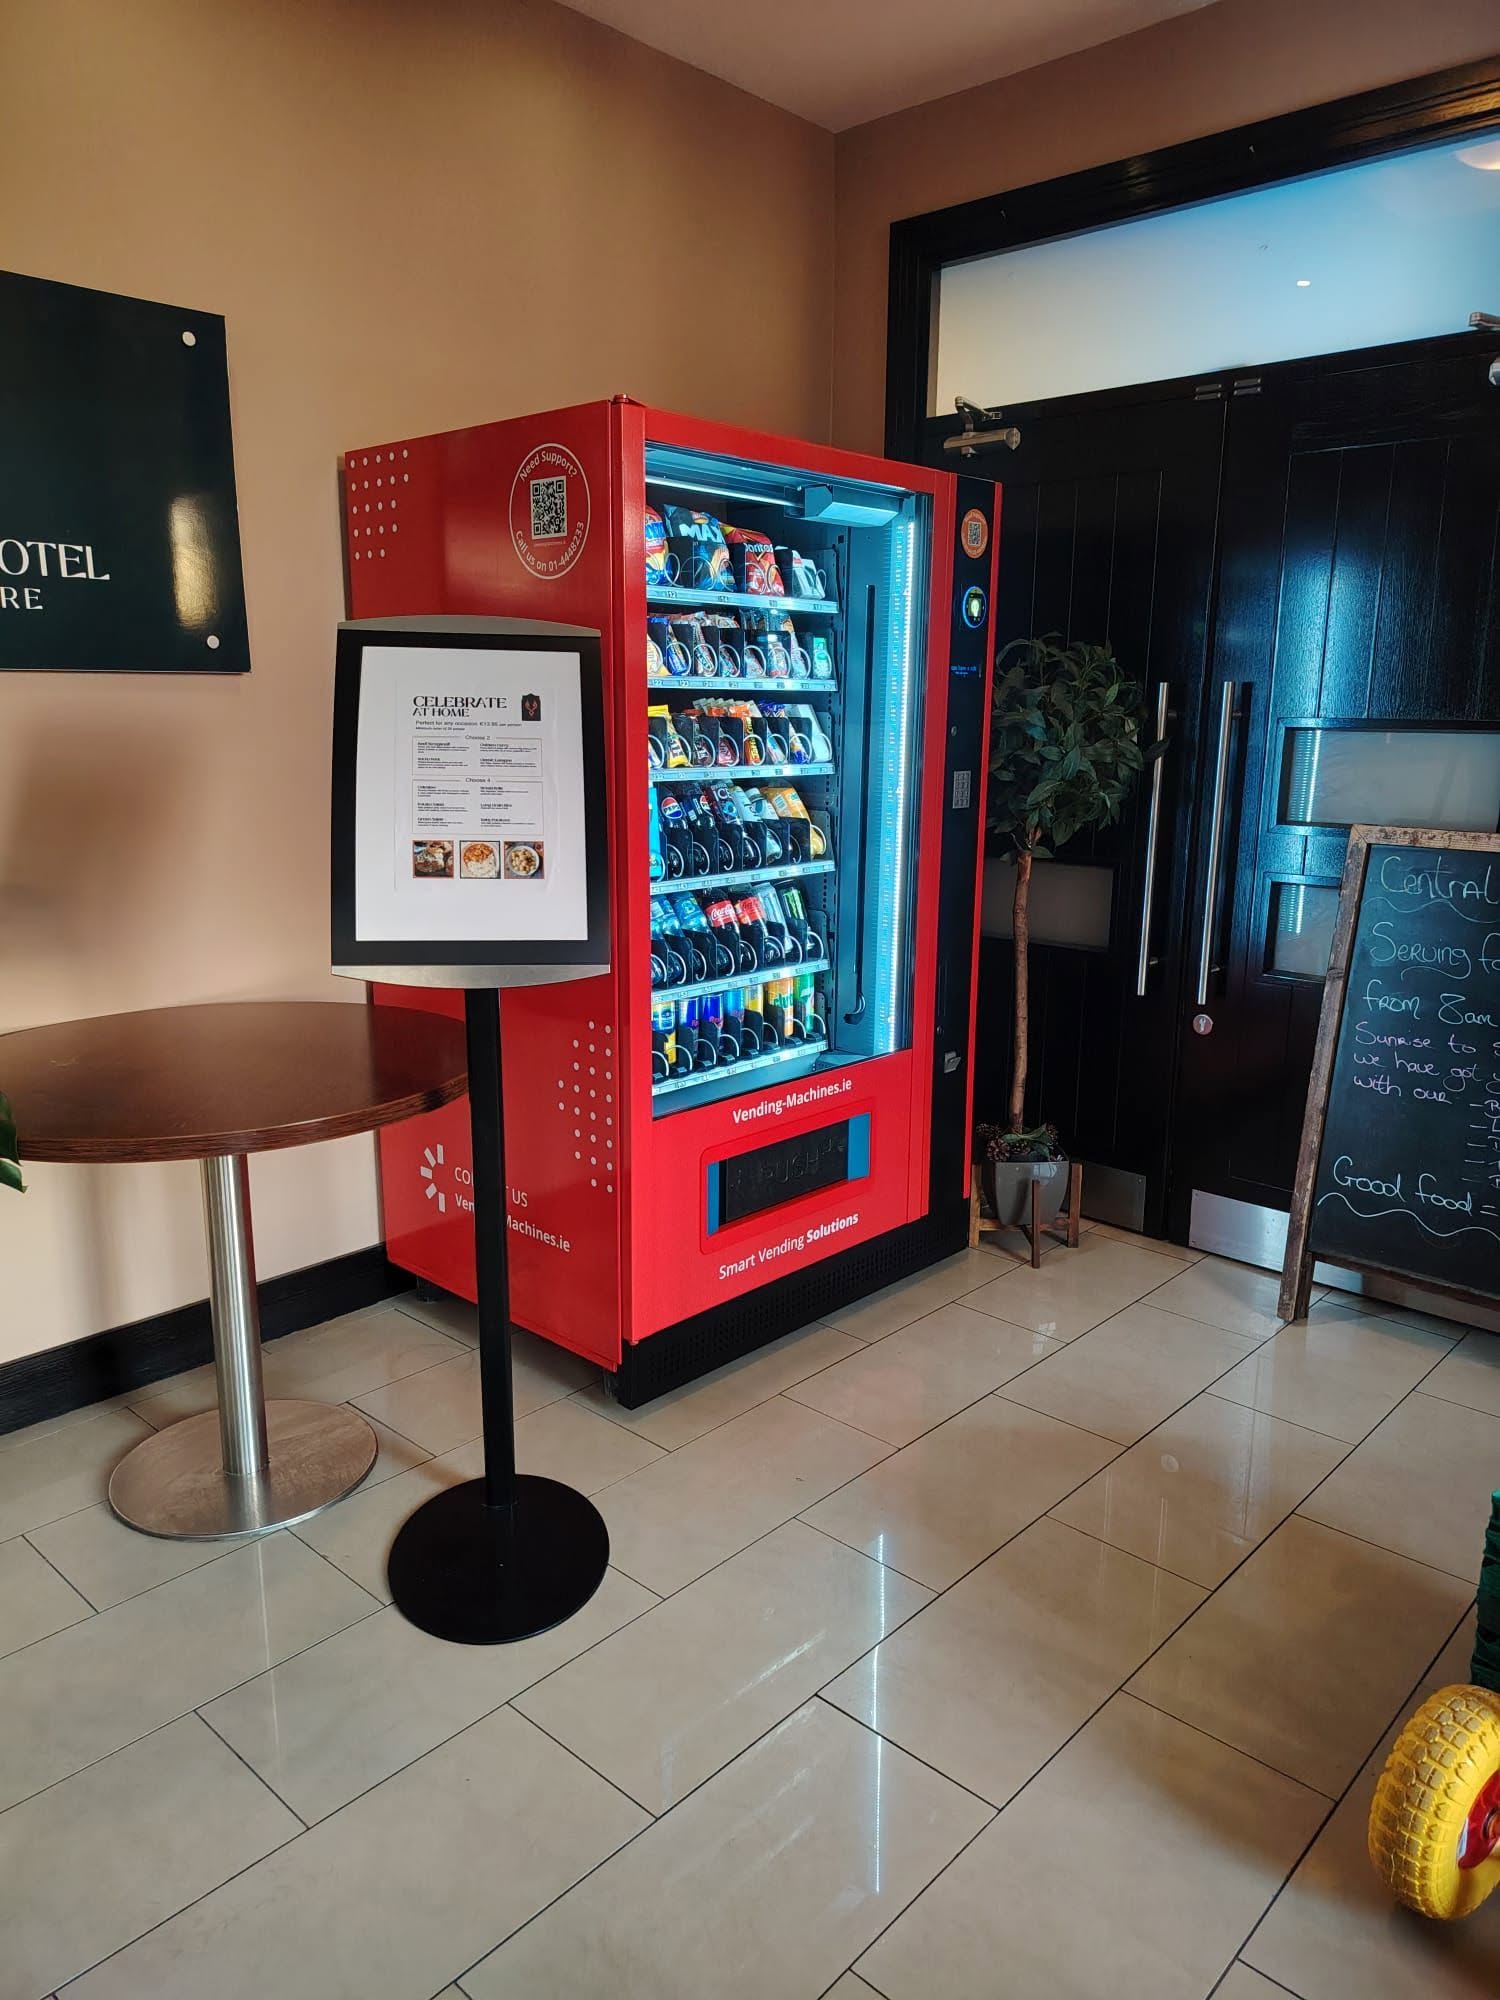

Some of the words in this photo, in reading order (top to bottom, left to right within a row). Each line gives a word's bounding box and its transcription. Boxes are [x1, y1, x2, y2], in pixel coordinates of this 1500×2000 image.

[519, 455, 540, 482] Need
[541, 450, 578, 478] Support?
[678, 523, 723, 543] MAX
[515, 530, 529, 554] Call
[526, 552, 536, 567] us
[536, 560, 547, 572] on
[412, 696, 507, 708] CELEBRATE
[412, 708, 431, 717] AT
[432, 708, 470, 718] HOME
[1355, 1021, 1433, 1049] Sunrise
[1447, 1033, 1477, 1054] to
[1353, 1052, 1386, 1068] we
[1394, 1051, 1440, 1076] have
[1442, 1063, 1484, 1092] got
[1353, 1074, 1402, 1097] with
[732, 1078, 852, 1125] Vending-Machines.ie
[511, 1187, 528, 1208] US
[1332, 1156, 1406, 1203] Good
[1415, 1173, 1474, 1219] food
[719, 1254, 756, 1280] Smart
[758, 1234, 805, 1264] Vending
[806, 1212, 859, 1244] Solutions
